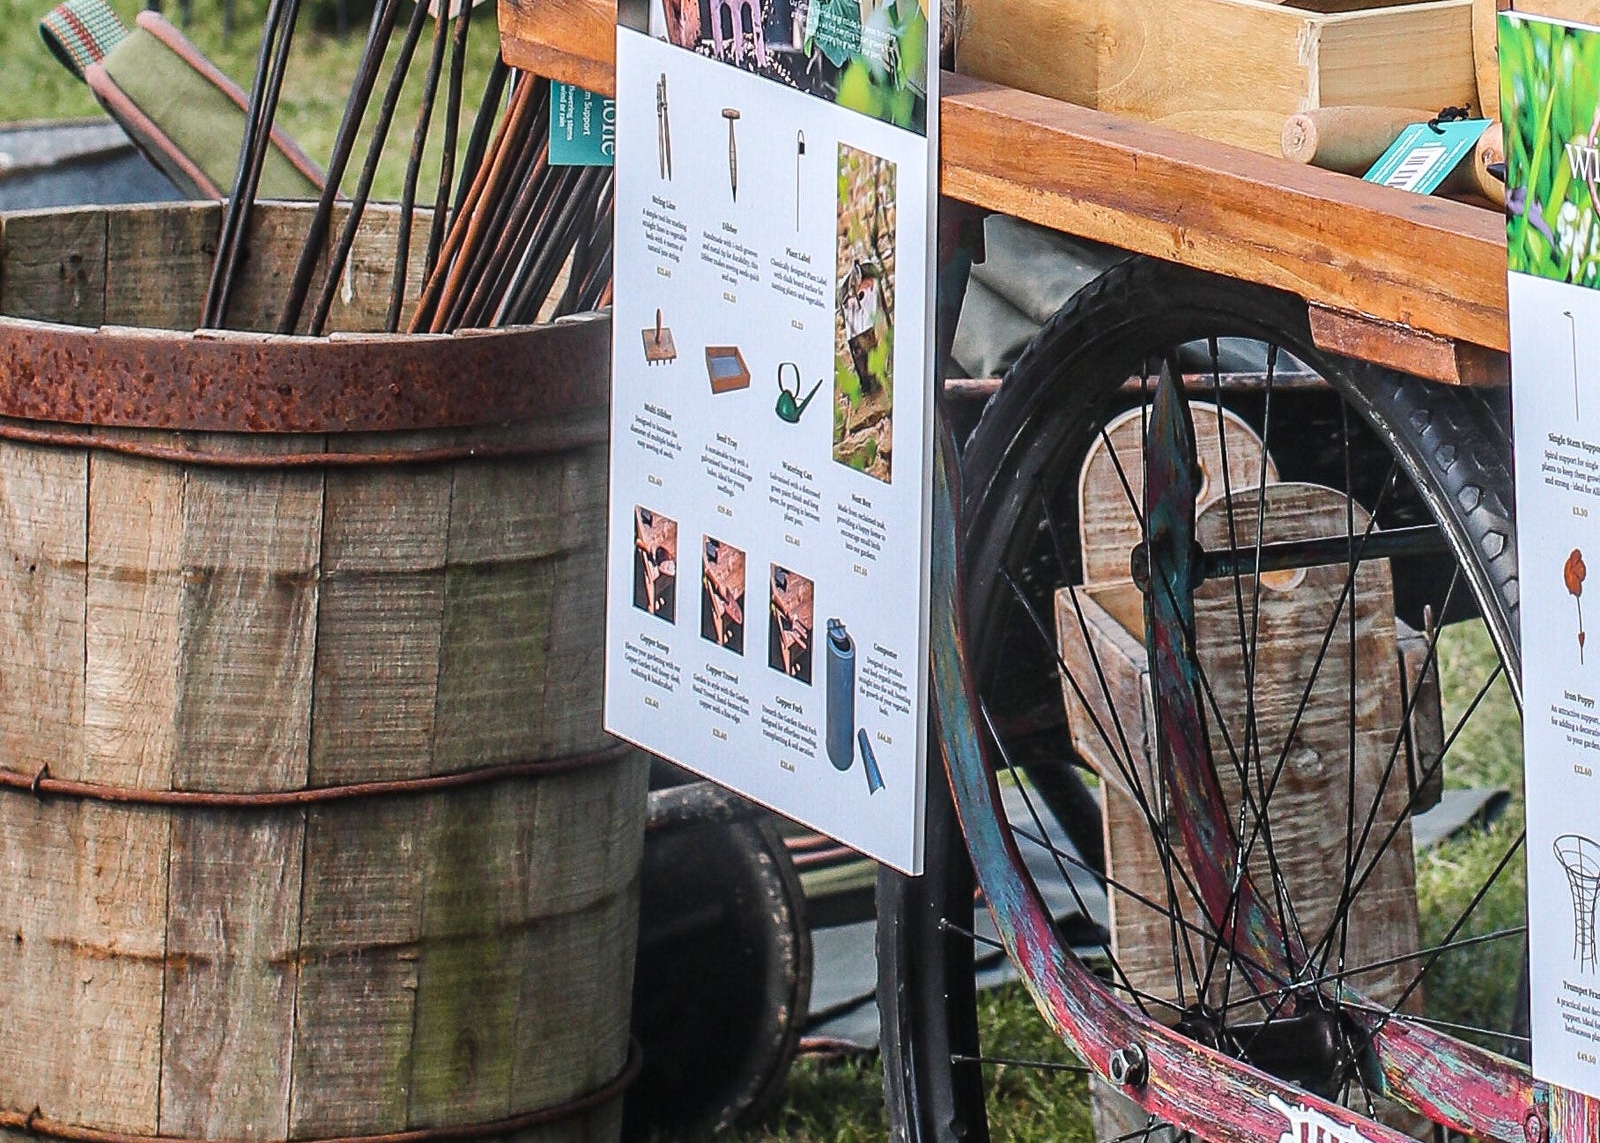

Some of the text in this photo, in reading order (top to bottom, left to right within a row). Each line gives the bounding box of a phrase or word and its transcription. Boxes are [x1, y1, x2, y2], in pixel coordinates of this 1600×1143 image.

[582, 102, 592, 135] Support
[786, 247, 810, 265] Plant Label
[727, 437, 738, 450] Tray
[1548, 432, 1565, 447] Single
[1566, 437, 1580, 448] Stem
[782, 460, 813, 481] Watering Can
[1541, 460, 1555, 474] plants
[1562, 465, 1572, 478] keep
[1574, 468, 1586, 479] them
[1558, 454, 1576, 467] support
[1585, 459, 1598, 471] single
[1544, 474, 1553, 484] and
[1554, 479, 1569, 490] strong
[1572, 481, 1584, 492] ideal
[639, 633, 655, 649] Copper
[706, 663, 722, 678] Copper
[775, 695, 790, 710] Copper
[1564, 690, 1594, 709] Iron Poppy
[1562, 979, 1587, 998] Trumpet
